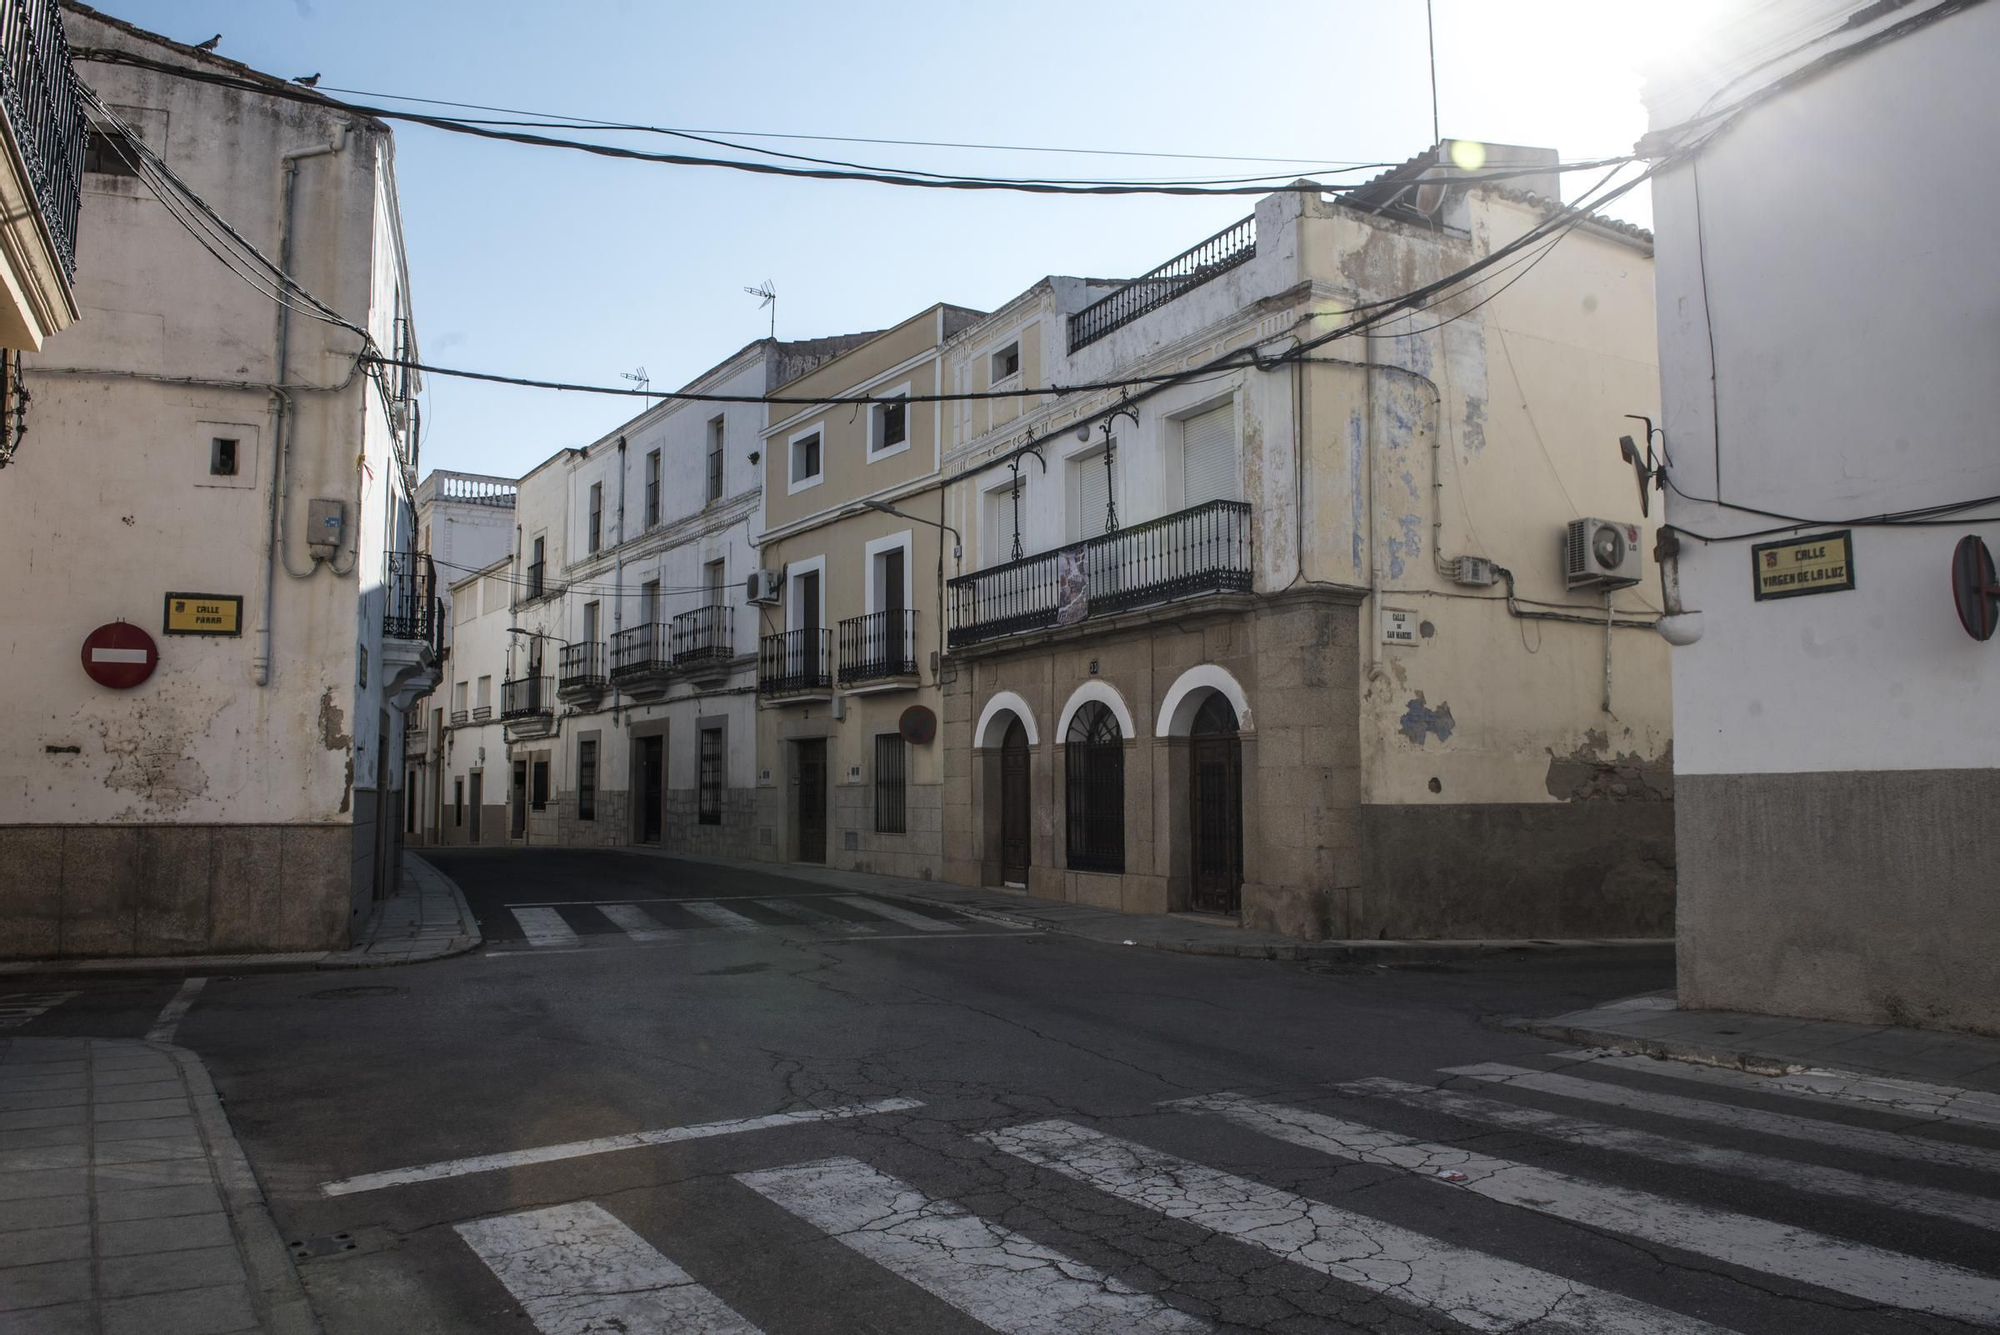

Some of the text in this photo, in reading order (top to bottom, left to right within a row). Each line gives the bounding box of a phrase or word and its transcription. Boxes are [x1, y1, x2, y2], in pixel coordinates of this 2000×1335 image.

[1628, 543, 1637, 551] LG
[1795, 546, 1826, 561] CALLE
[1763, 566, 1844, 588] VIRGEN DE LA LUZ
[196, 606, 220, 614] CALLE
[195, 616, 222, 624] PARRA
[1392, 613, 1406, 622] CALLE
[1386, 630, 1412, 640] SAN MARCOS
